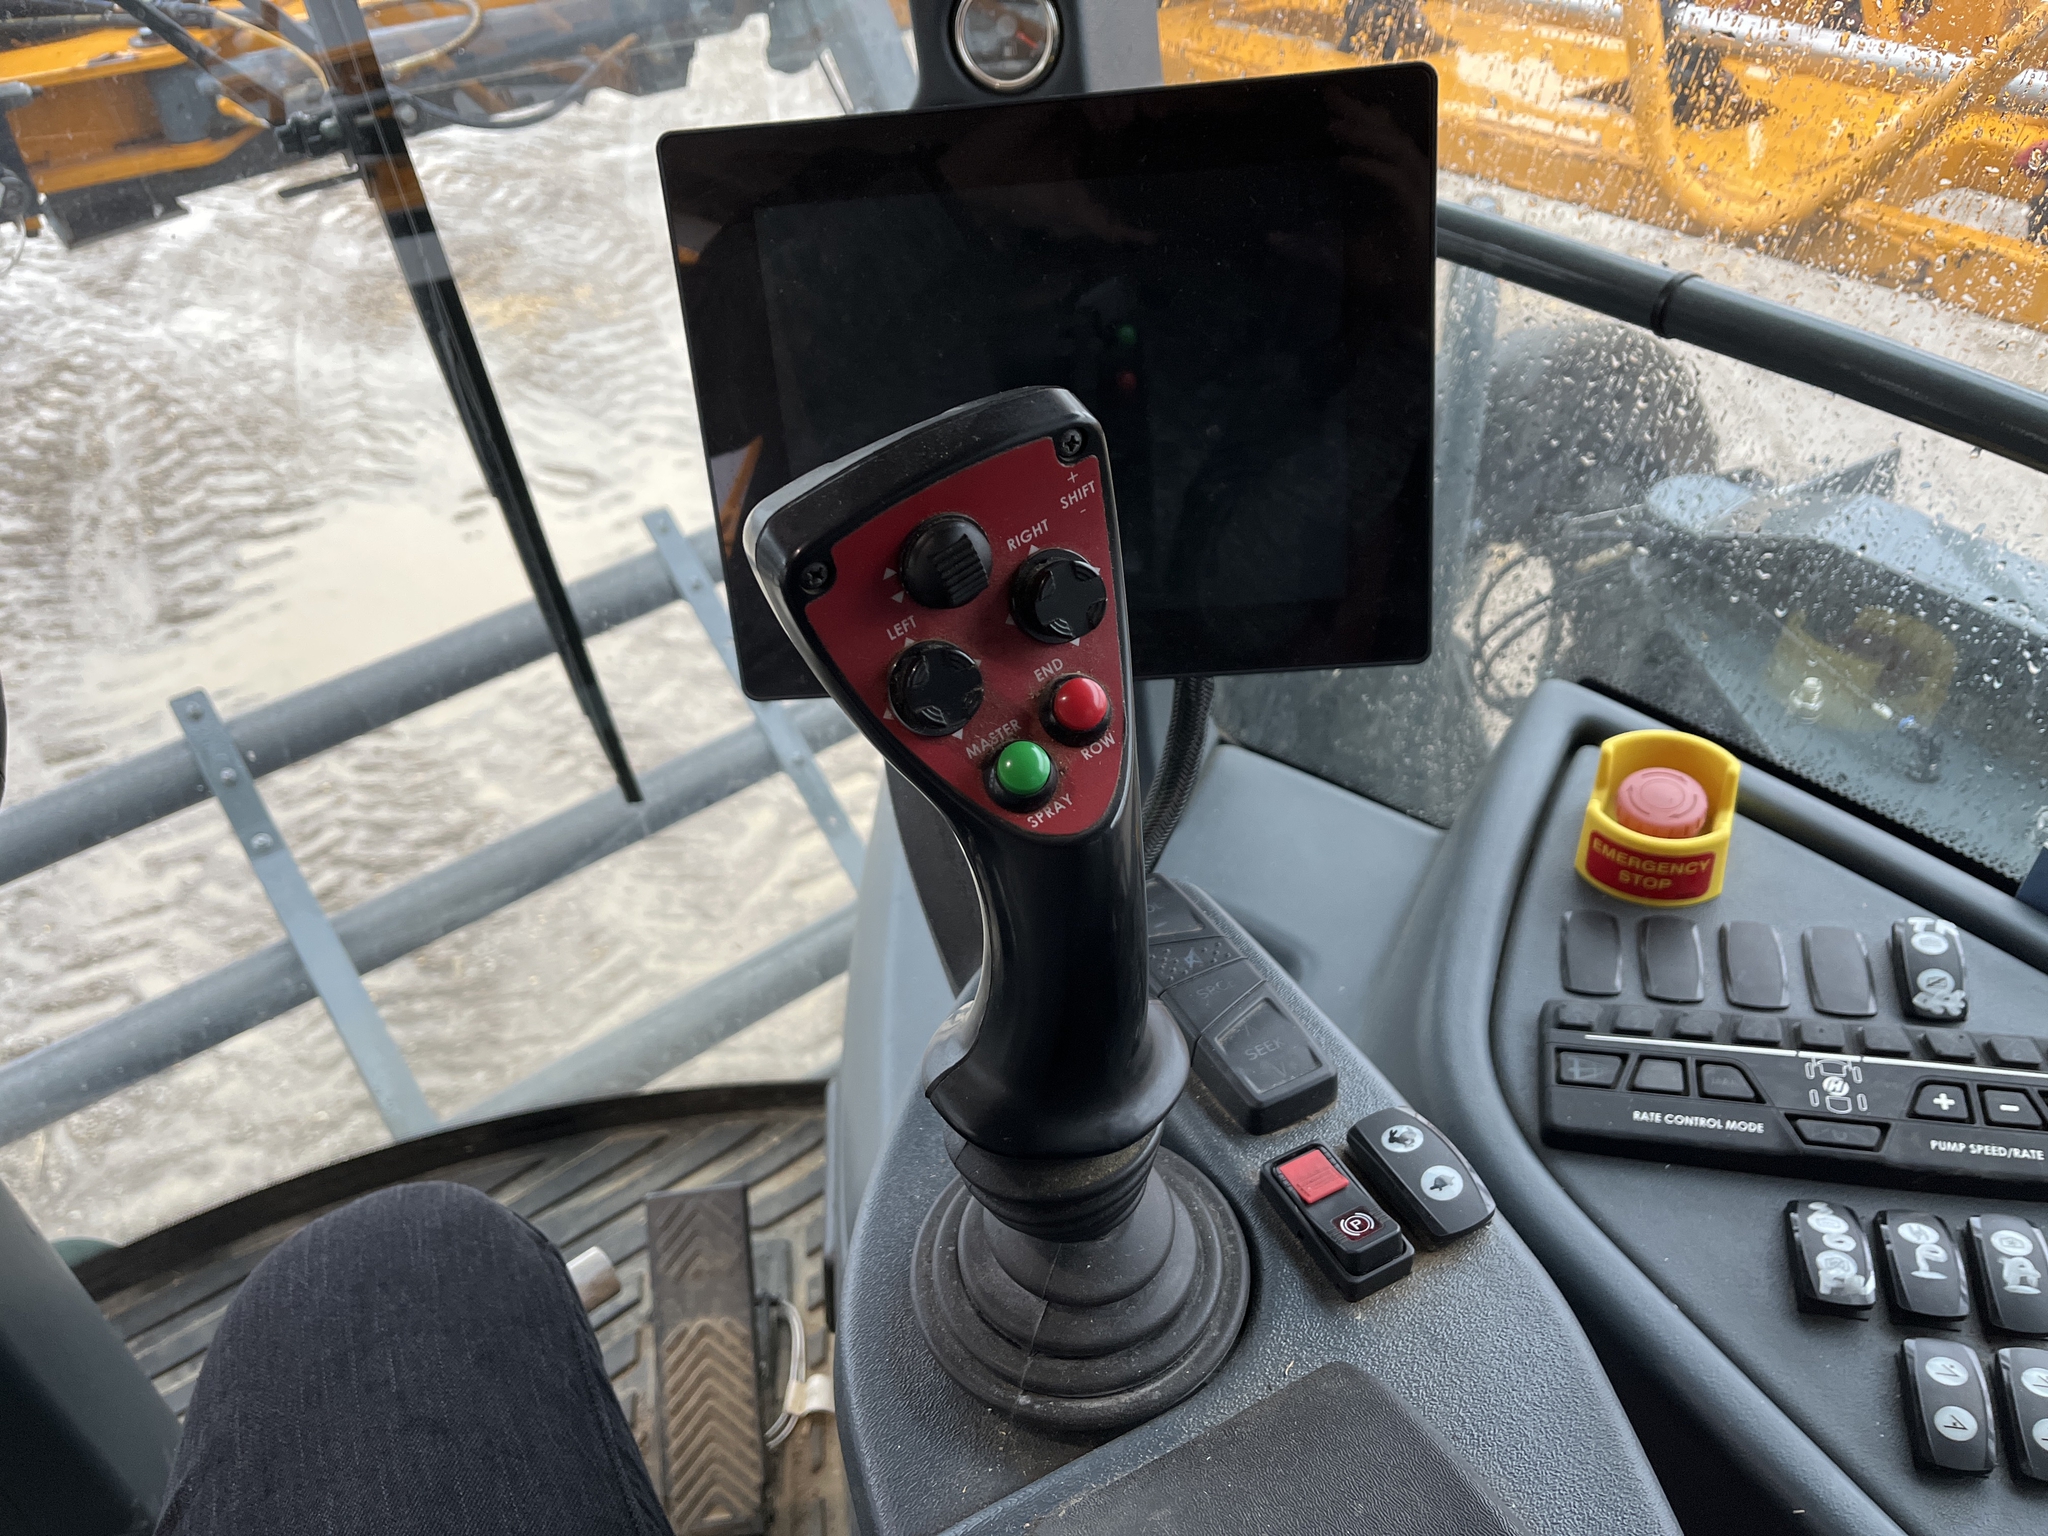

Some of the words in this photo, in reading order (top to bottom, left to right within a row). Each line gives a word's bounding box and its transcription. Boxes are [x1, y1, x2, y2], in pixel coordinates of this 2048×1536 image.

[1058, 480, 1097, 511] SHIFT
[1006, 518, 1050, 552] RIGHT
[886, 615, 917, 641] LEFT
[1033, 658, 1064, 684] END
[965, 718, 1022, 760] MASTER
[1079, 732, 1117, 761] ROW
[1027, 793, 1074, 829] SPRAY
[1592, 838, 1712, 876] EMERGENCY
[1618, 869, 1673, 891] STOP
[1244, 1037, 1285, 1061] SEEK
[1632, 1109, 1662, 1124] RATE
[1663, 1113, 1724, 1130] CONTROL
[1724, 1119, 1765, 1134] MODE
[1929, 1139, 1967, 1154] PUMP
[1968, 1143, 2046, 1161] SPEED/RATE
